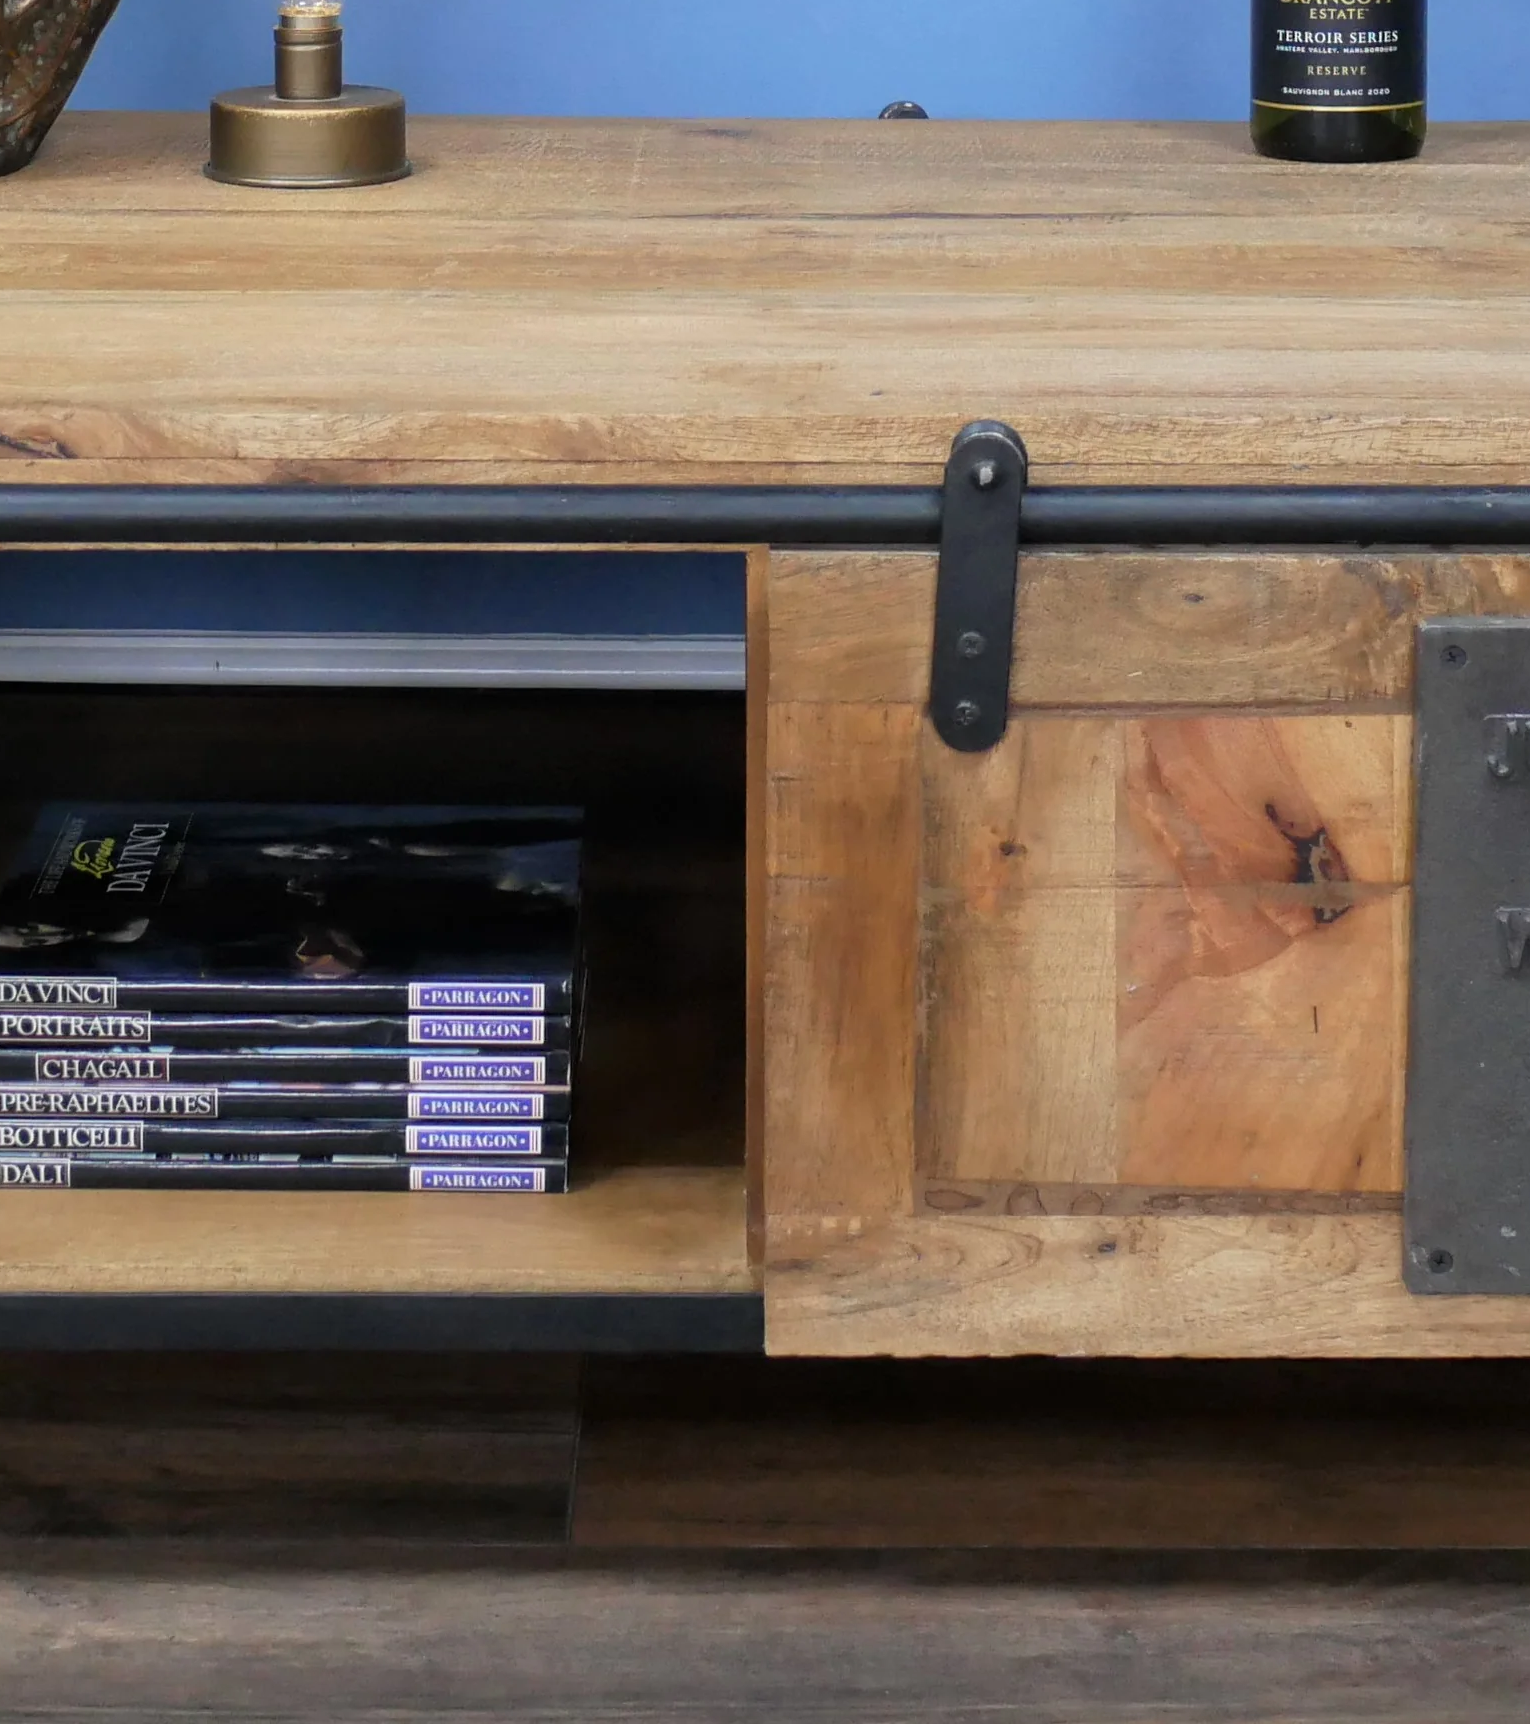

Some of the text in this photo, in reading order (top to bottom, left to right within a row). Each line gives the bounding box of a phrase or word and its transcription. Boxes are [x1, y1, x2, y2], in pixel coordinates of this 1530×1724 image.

[1309, 8, 1365, 20] ESTATE
[1276, 29, 1399, 44] TERROIR SERIES
[1307, 65, 1367, 76] RESERVE
[1282, 86, 1330, 96] SAUVIGNON
[1333, 88, 1364, 96] BLANC
[116, 822, 170, 869] VINCI
[37, 982, 112, 1004] VINCI
[431, 990, 521, 1005] PARRAGON
[1, 1016, 146, 1038] PORTRAITS
[431, 1024, 521, 1038] PARRAGON
[42, 1059, 163, 1078] CHAGALL
[432, 1064, 523, 1079] PARRAGON
[0, 1093, 212, 1115] PRE-RAPHAELITES
[430, 1100, 520, 1115] PARRAGON
[0, 1127, 137, 1148] BOTTICELLI
[428, 1134, 518, 1149] PARRAGON
[2, 1164, 64, 1184] DALI
[432, 1174, 522, 1188] PARRAGON
